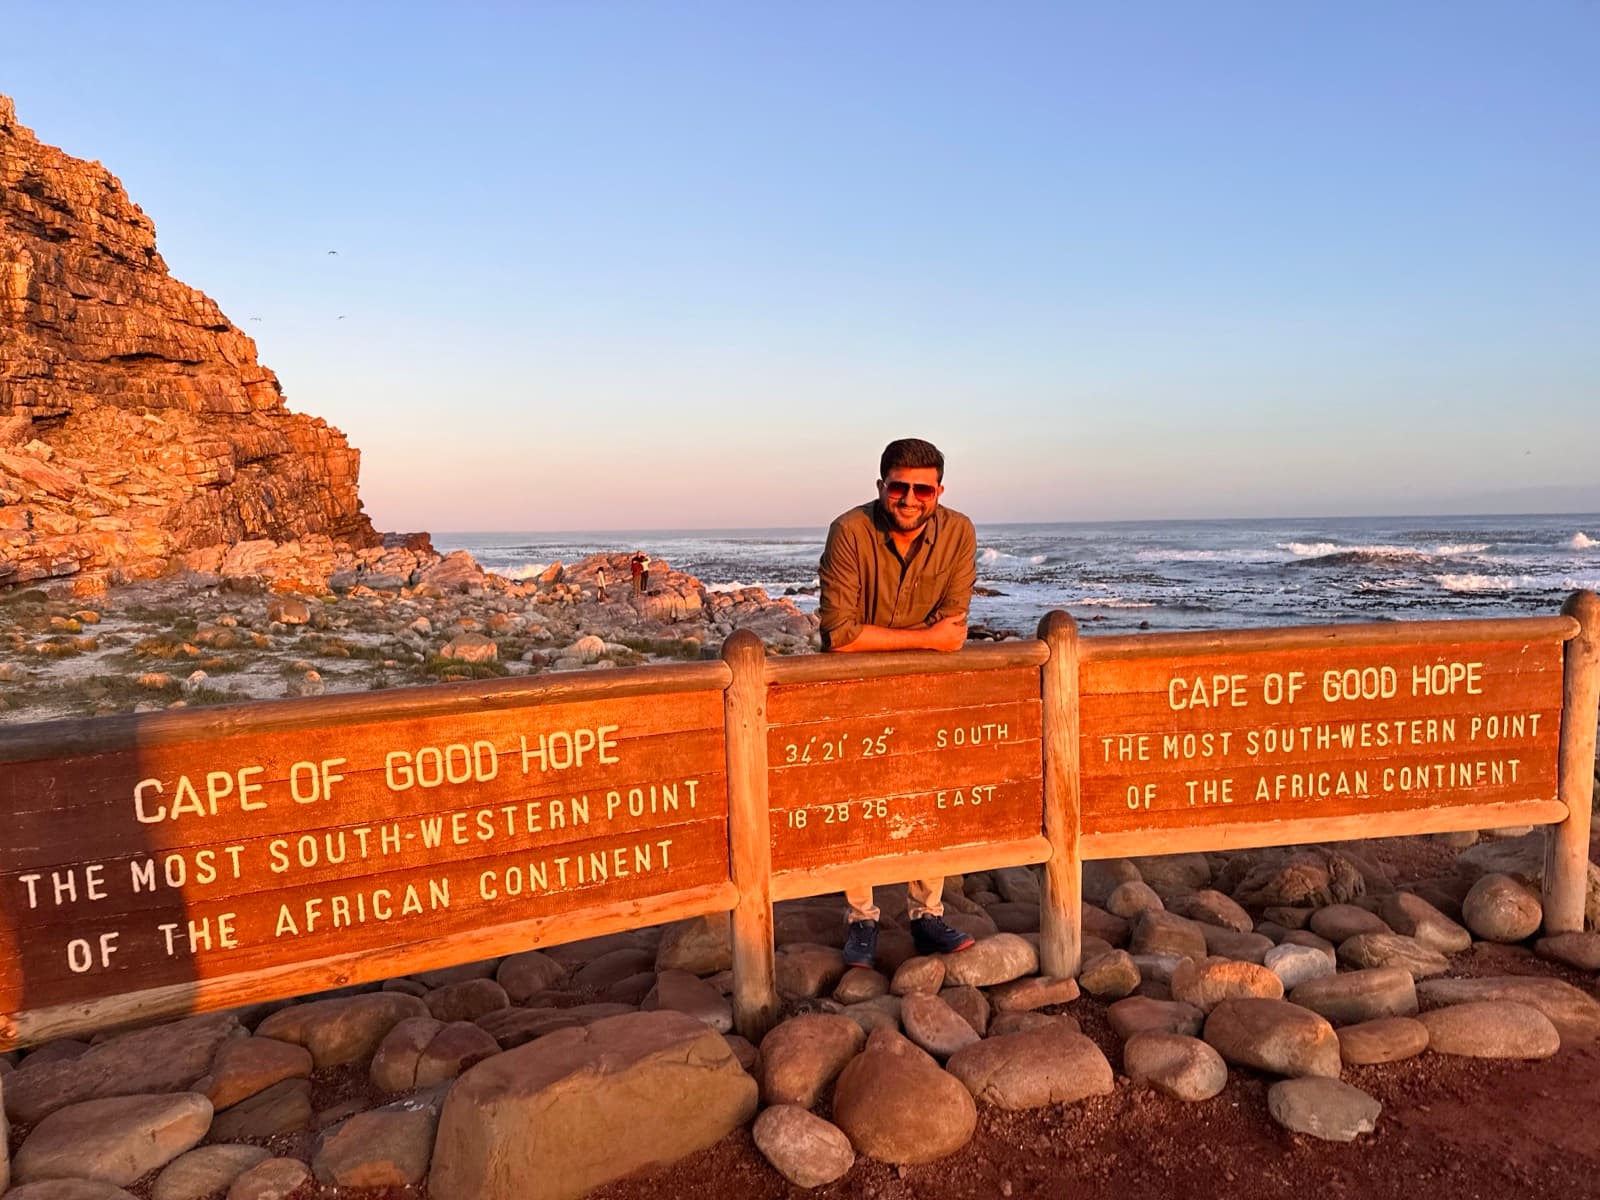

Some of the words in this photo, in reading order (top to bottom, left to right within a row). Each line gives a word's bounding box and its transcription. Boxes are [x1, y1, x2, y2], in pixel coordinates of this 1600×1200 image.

[1168, 675, 1248, 710] CAPE
[1263, 671, 1304, 705] OF
[1323, 666, 1397, 702] GOOD
[1412, 662, 1483, 696] HOPE
[936, 723, 1008, 748] SOUTH
[1101, 735, 1150, 762] THE
[1163, 732, 1232, 759] MOST
[1246, 718, 1455, 755] SOUTH-WESTERN
[1471, 714, 1541, 741] POINT
[134, 766, 267, 823] CAPE
[290, 757, 347, 804] OF
[385, 740, 498, 791] GOOD
[520, 724, 619, 773] HOPE
[1126, 783, 1157, 810] OF
[1185, 778, 1233, 805] THE
[1255, 770, 1368, 801] AFRICAN
[1383, 759, 1521, 792] CONTINENT
[862, 799, 887, 819] 26
[937, 786, 996, 808] EAST
[19, 865, 108, 909] THE
[130, 845, 245, 893] MOST
[269, 796, 590, 873] SOUTH-WESTERN
[606, 780, 699, 820] POINT
[67, 932, 120, 974] OF
[158, 912, 239, 956] THE
[275, 878, 450, 938] AFRICAN
[479, 840, 673, 901] CONTINENT
